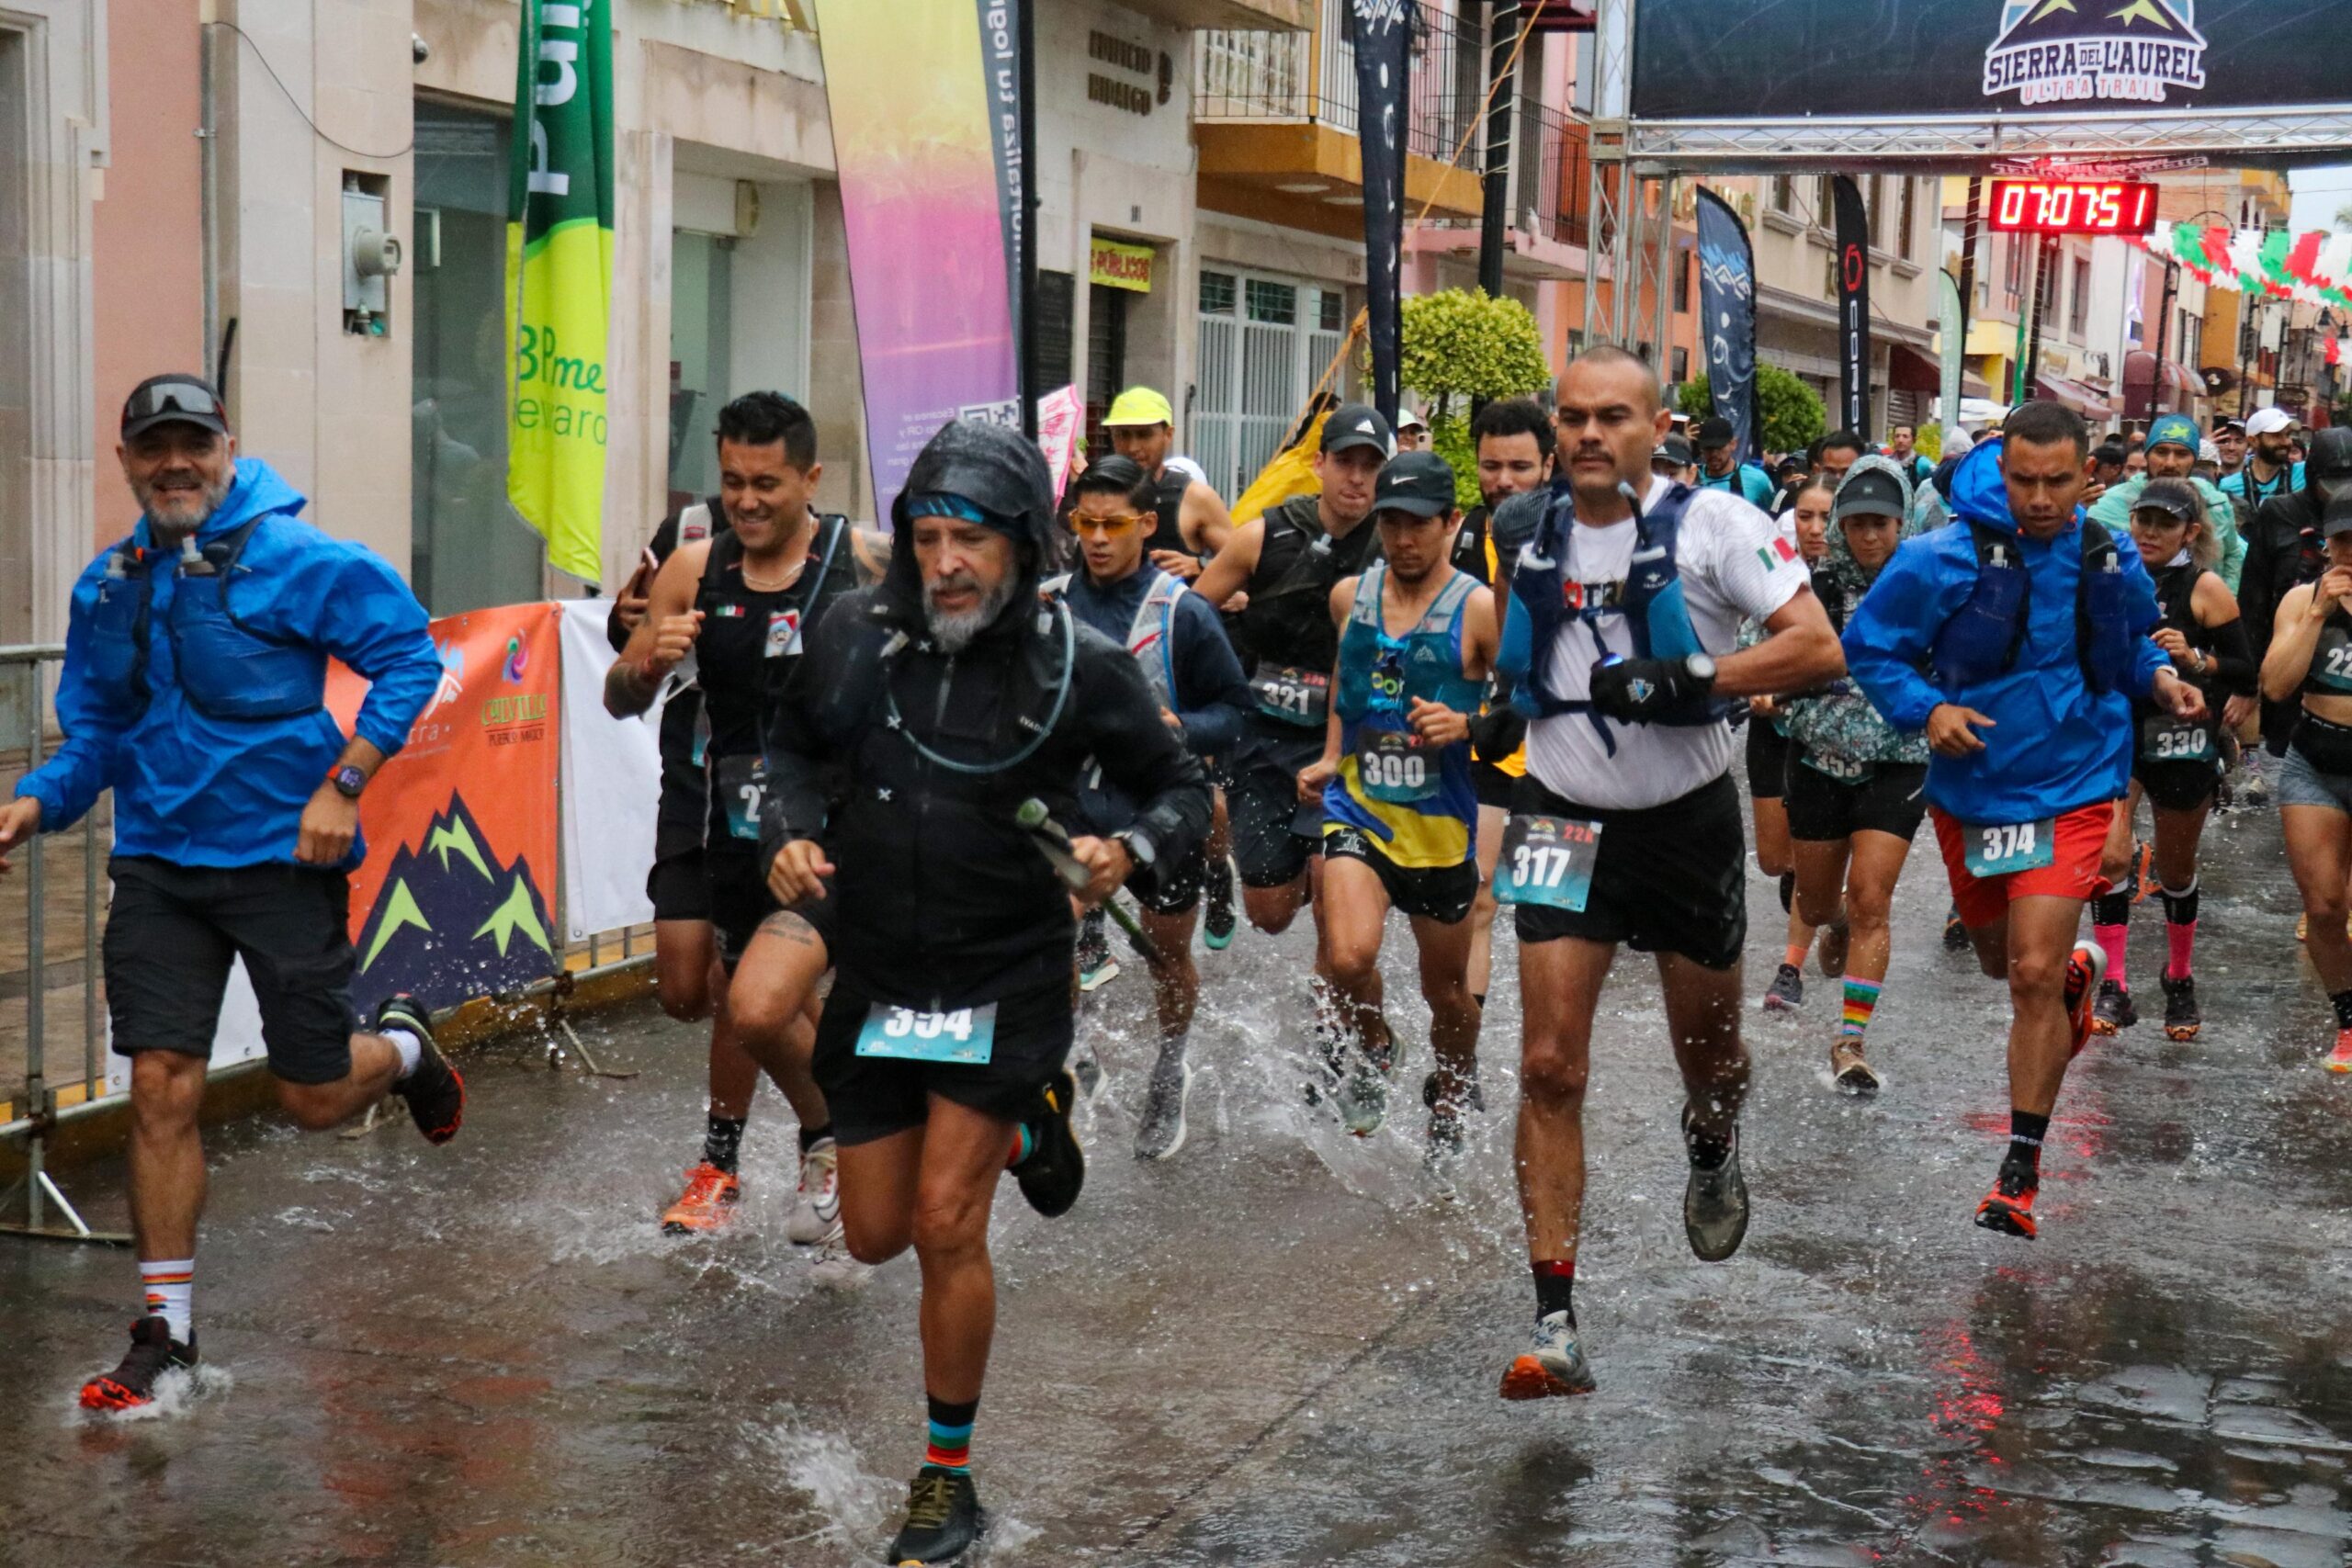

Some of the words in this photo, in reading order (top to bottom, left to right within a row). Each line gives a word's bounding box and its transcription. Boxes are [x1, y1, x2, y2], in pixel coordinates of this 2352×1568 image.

[1988, 43, 2077, 90] SIERRA
[2079, 49, 2102, 67] DEL
[1088, 73, 1151, 117] HIDALGO
[2024, 79, 2089, 101] ULTRA
[2099, 79, 2162, 98] TRAIL
[1262, 682, 1309, 715] 321
[2156, 728, 2207, 757] 330
[1364, 751, 1425, 787] 300
[741, 784, 767, 822] 2
[1983, 823, 2036, 861] 374
[1512, 845, 1571, 887] 317
